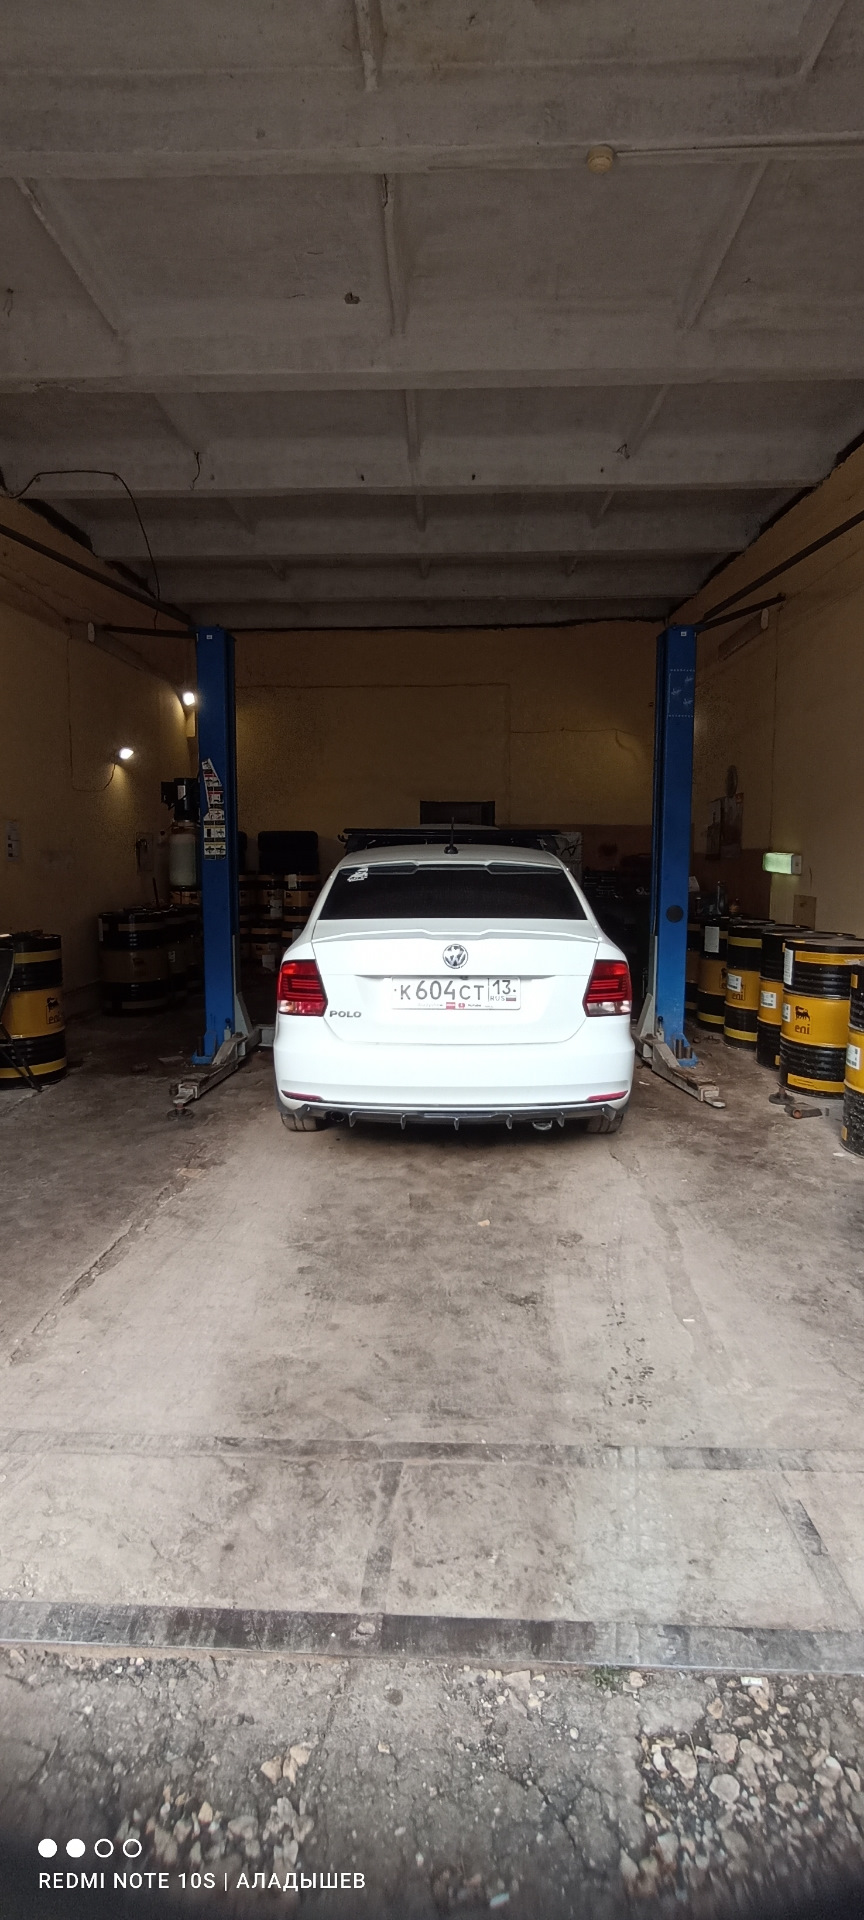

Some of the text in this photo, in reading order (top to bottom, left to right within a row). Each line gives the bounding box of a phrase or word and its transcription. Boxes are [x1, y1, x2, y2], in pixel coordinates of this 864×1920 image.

[493, 980, 511, 995] 13
[329, 1010, 362, 1018] POLO
[795, 1023, 810, 1035] eni
